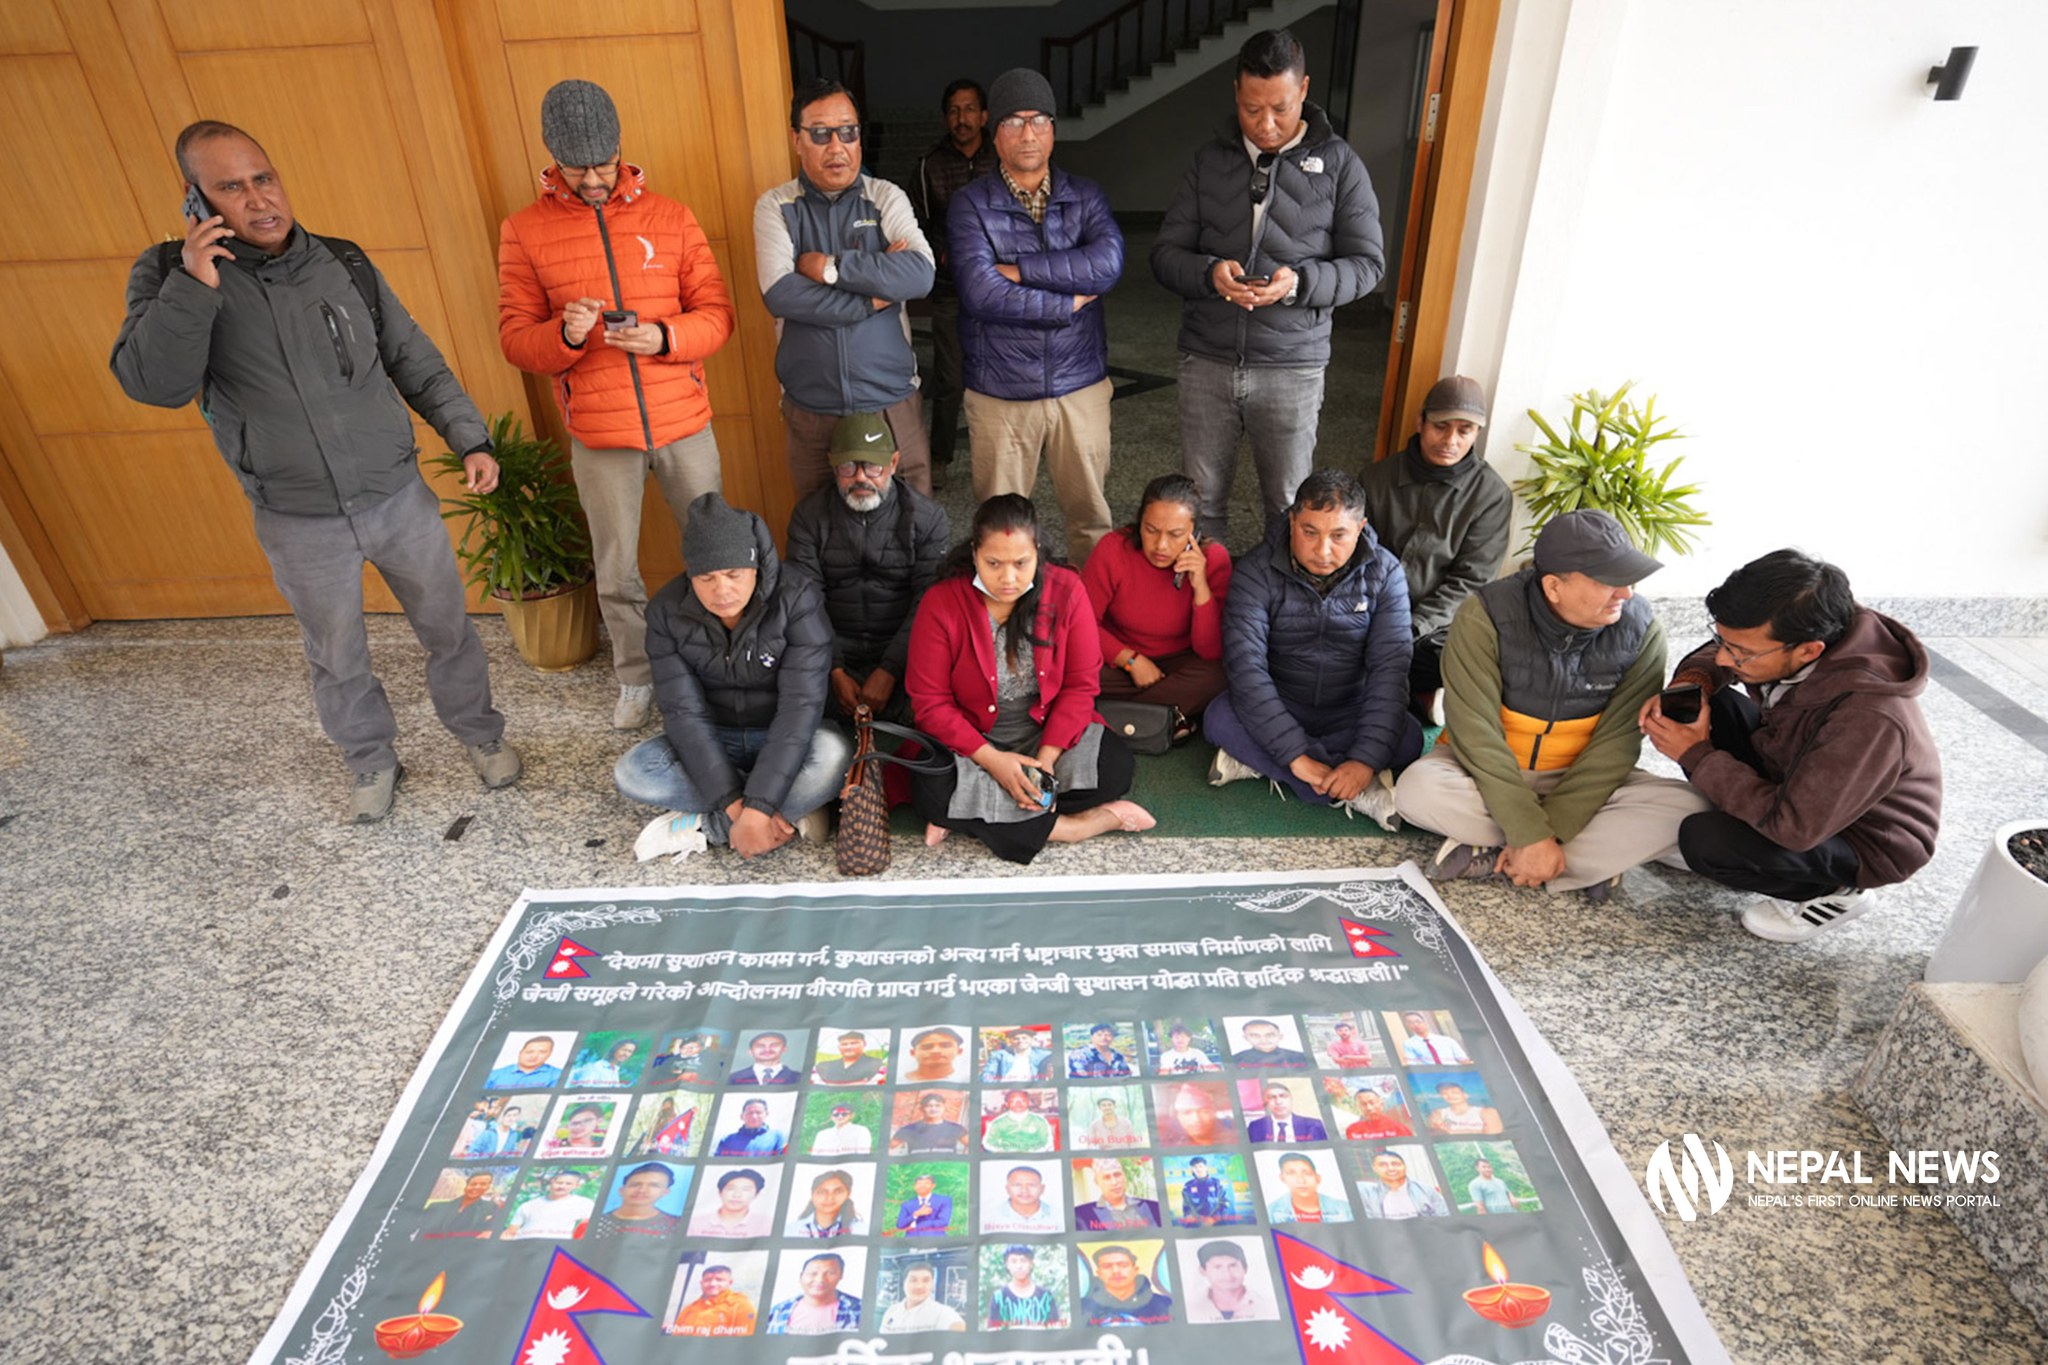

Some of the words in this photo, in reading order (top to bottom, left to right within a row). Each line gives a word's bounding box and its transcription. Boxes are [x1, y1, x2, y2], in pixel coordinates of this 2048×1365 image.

[665, 951, 738, 972] सुशासन
[739, 952, 797, 967] कायम
[835, 946, 936, 968] कुशासनको
[990, 942, 1021, 962] गर्न
[1023, 946, 1093, 965] भ्रष्टाचार
[1096, 944, 1139, 962] मुक्त
[1141, 942, 1198, 957] समाज
[1200, 934, 1288, 955] निर्माणको
[1288, 934, 1332, 951] लागि
[574, 982, 639, 1006] समूहले
[641, 981, 695, 1000] गरेको
[697, 980, 804, 1000] आन्दोलनमा
[806, 977, 874, 997] वीरगति
[877, 982, 922, 997] प्राप्त
[924, 973, 956, 997] गर्नु
[959, 979, 1017, 996] भएका
[1072, 976, 1148, 996] सुशासन
[1150, 969, 1200, 989] योद्धा
[1202, 967, 1239, 987] प्रति
[1241, 964, 1304, 988] हार्दिक
[713, 1323, 748, 1335] dhami
